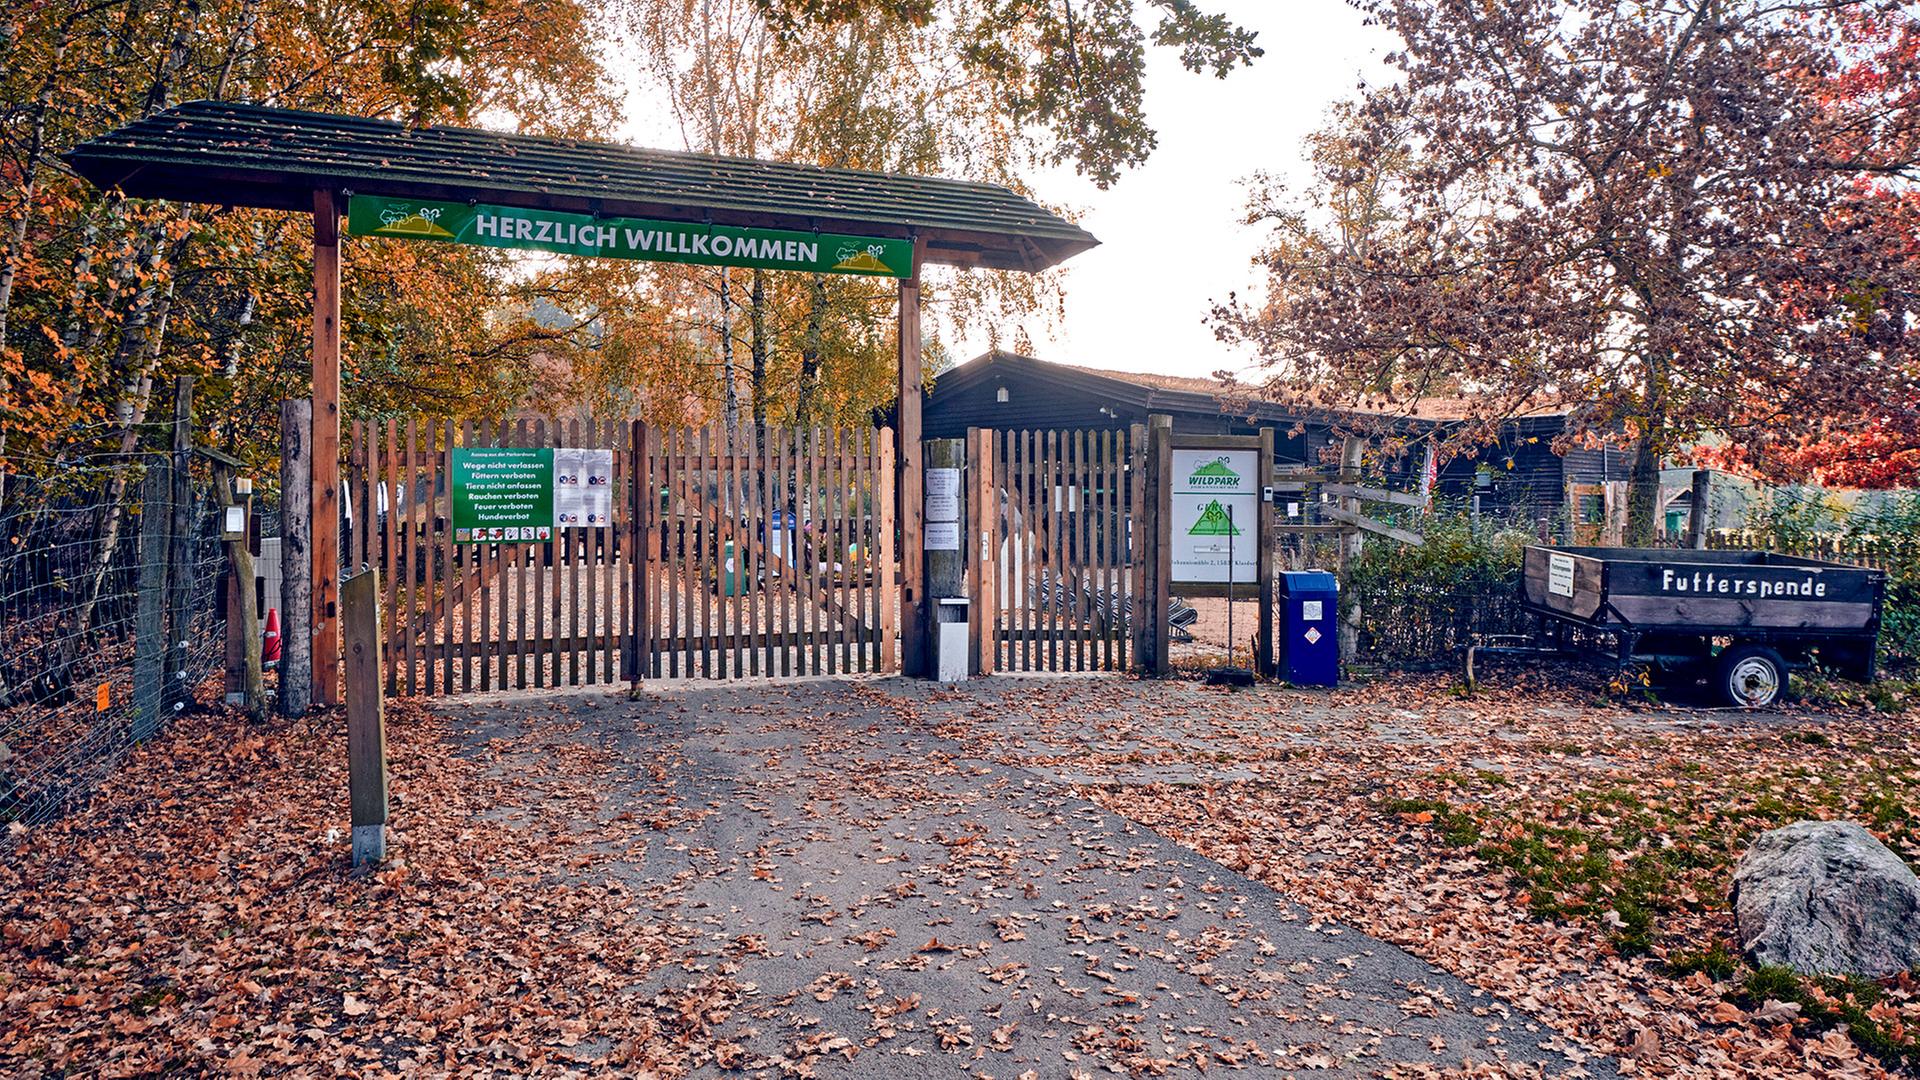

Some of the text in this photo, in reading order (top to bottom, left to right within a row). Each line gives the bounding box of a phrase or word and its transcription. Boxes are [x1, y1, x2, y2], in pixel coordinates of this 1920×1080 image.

[476, 214, 818, 263] HERZLICH WILLKOMMEN
[463, 462, 486, 470] Wege
[465, 482, 485, 490] Tiere
[1189, 476, 1240, 486] WILDPARK
[1662, 569, 1826, 598] Futterspende
